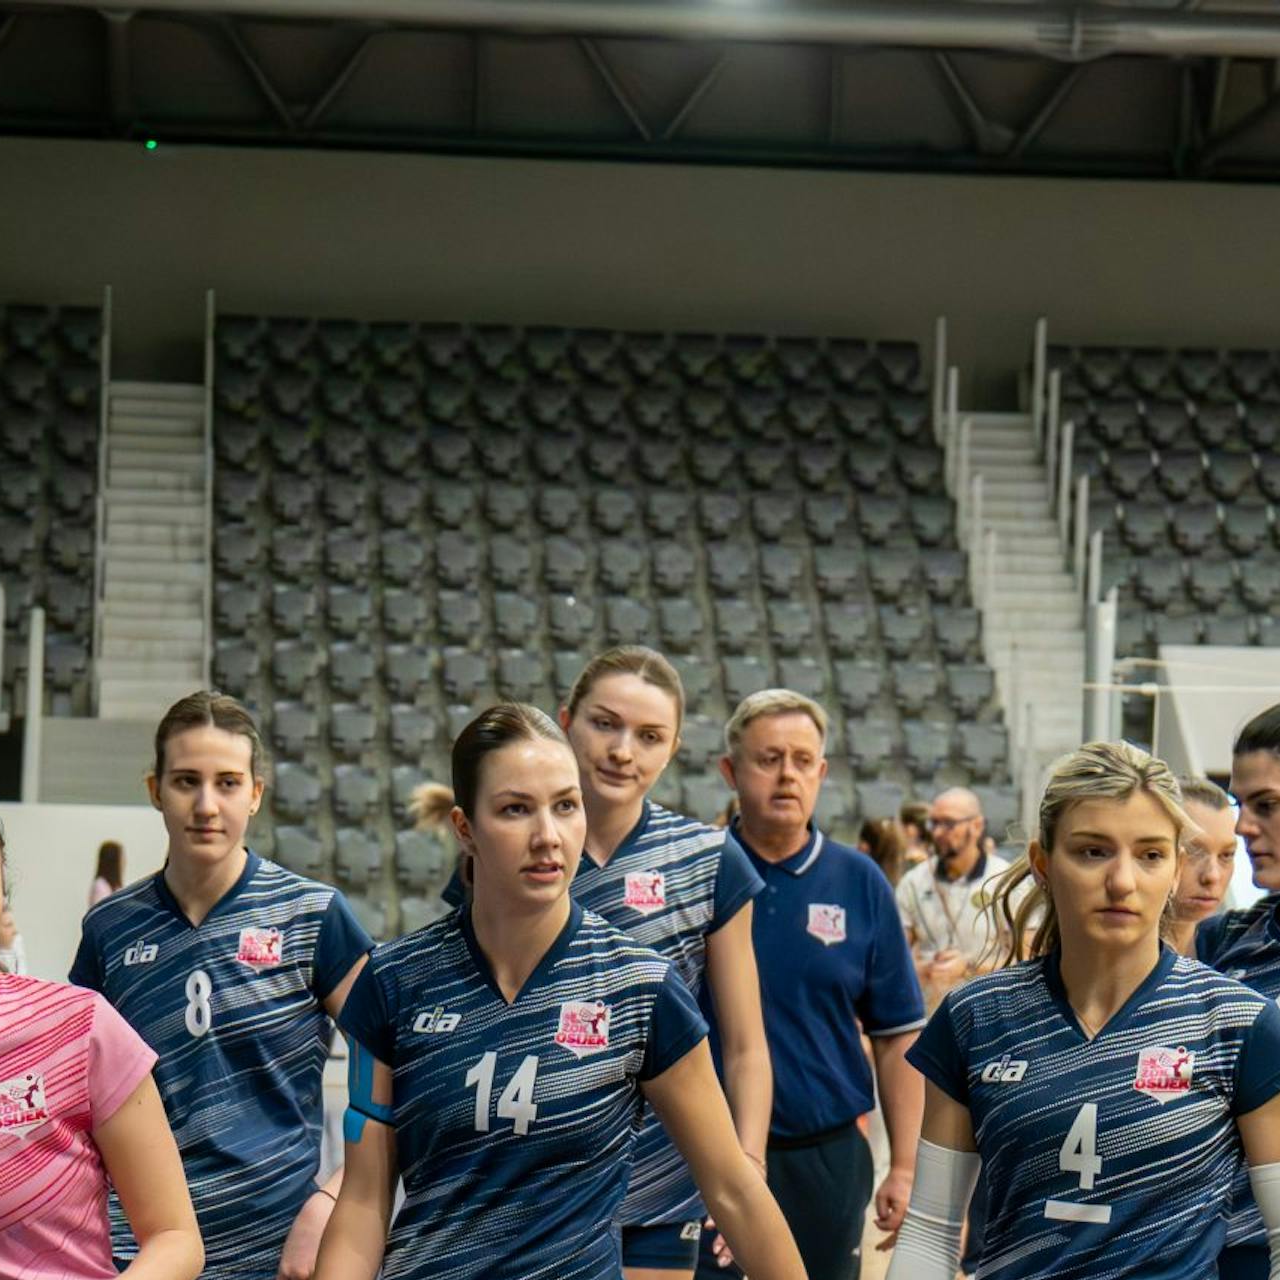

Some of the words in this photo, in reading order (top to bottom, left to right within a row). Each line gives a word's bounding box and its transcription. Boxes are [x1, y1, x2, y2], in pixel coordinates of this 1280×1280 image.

[184, 969, 213, 1038] 8
[464, 1051, 540, 1136] 14
[1134, 1078, 1191, 1090] OSIJEK
[1059, 1102, 1103, 1190] 4
